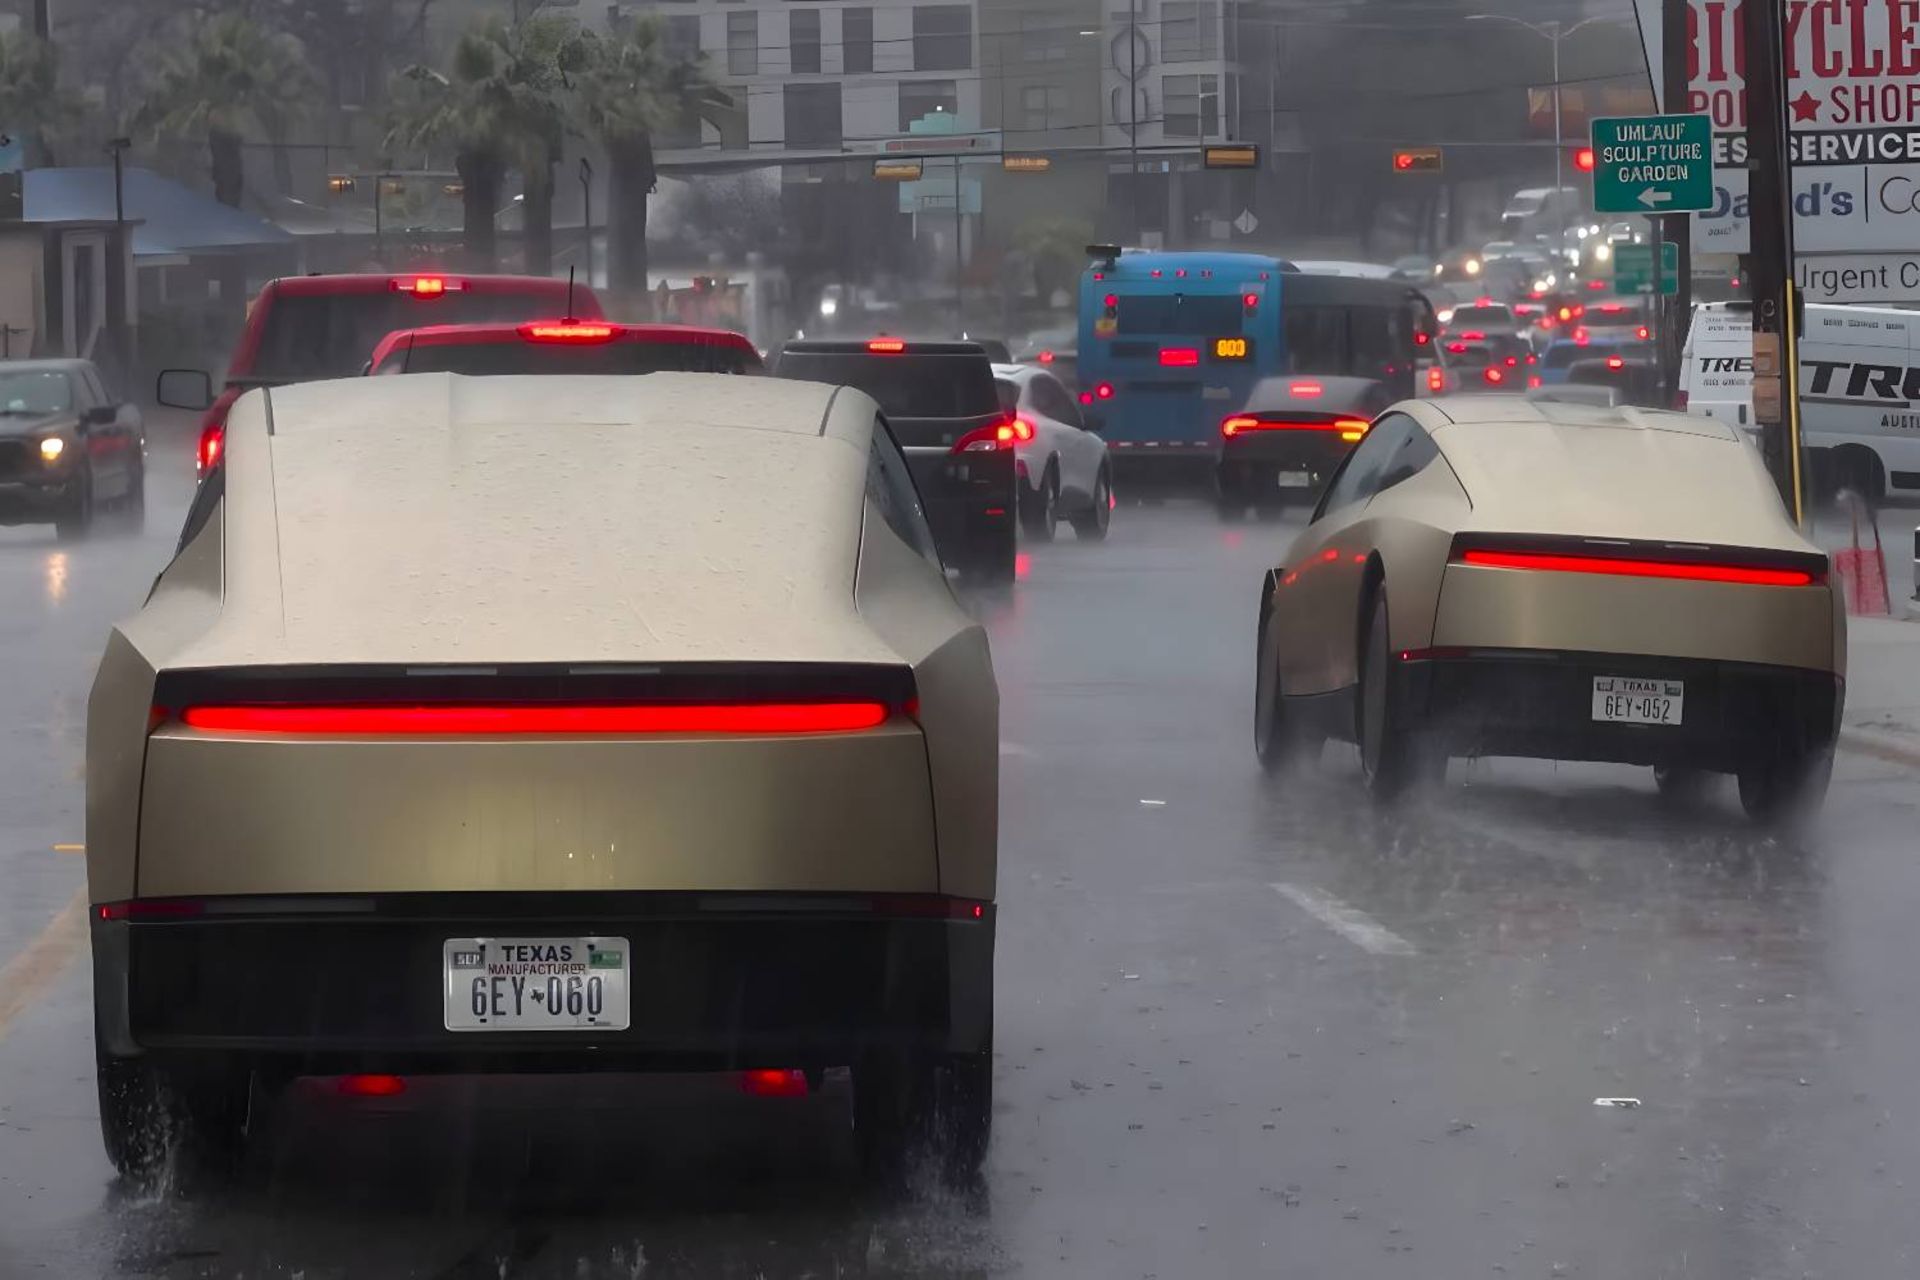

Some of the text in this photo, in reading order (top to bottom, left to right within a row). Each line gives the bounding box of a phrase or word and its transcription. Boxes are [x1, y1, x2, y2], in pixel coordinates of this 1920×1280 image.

[1616, 123, 1686, 142] UMLAUF
[1603, 143, 1702, 163] SCULPTURE
[1618, 164, 1688, 183] GARDEN
[1698, 182, 1853, 219] Dad's
[501, 945, 572, 962] TEXAS
